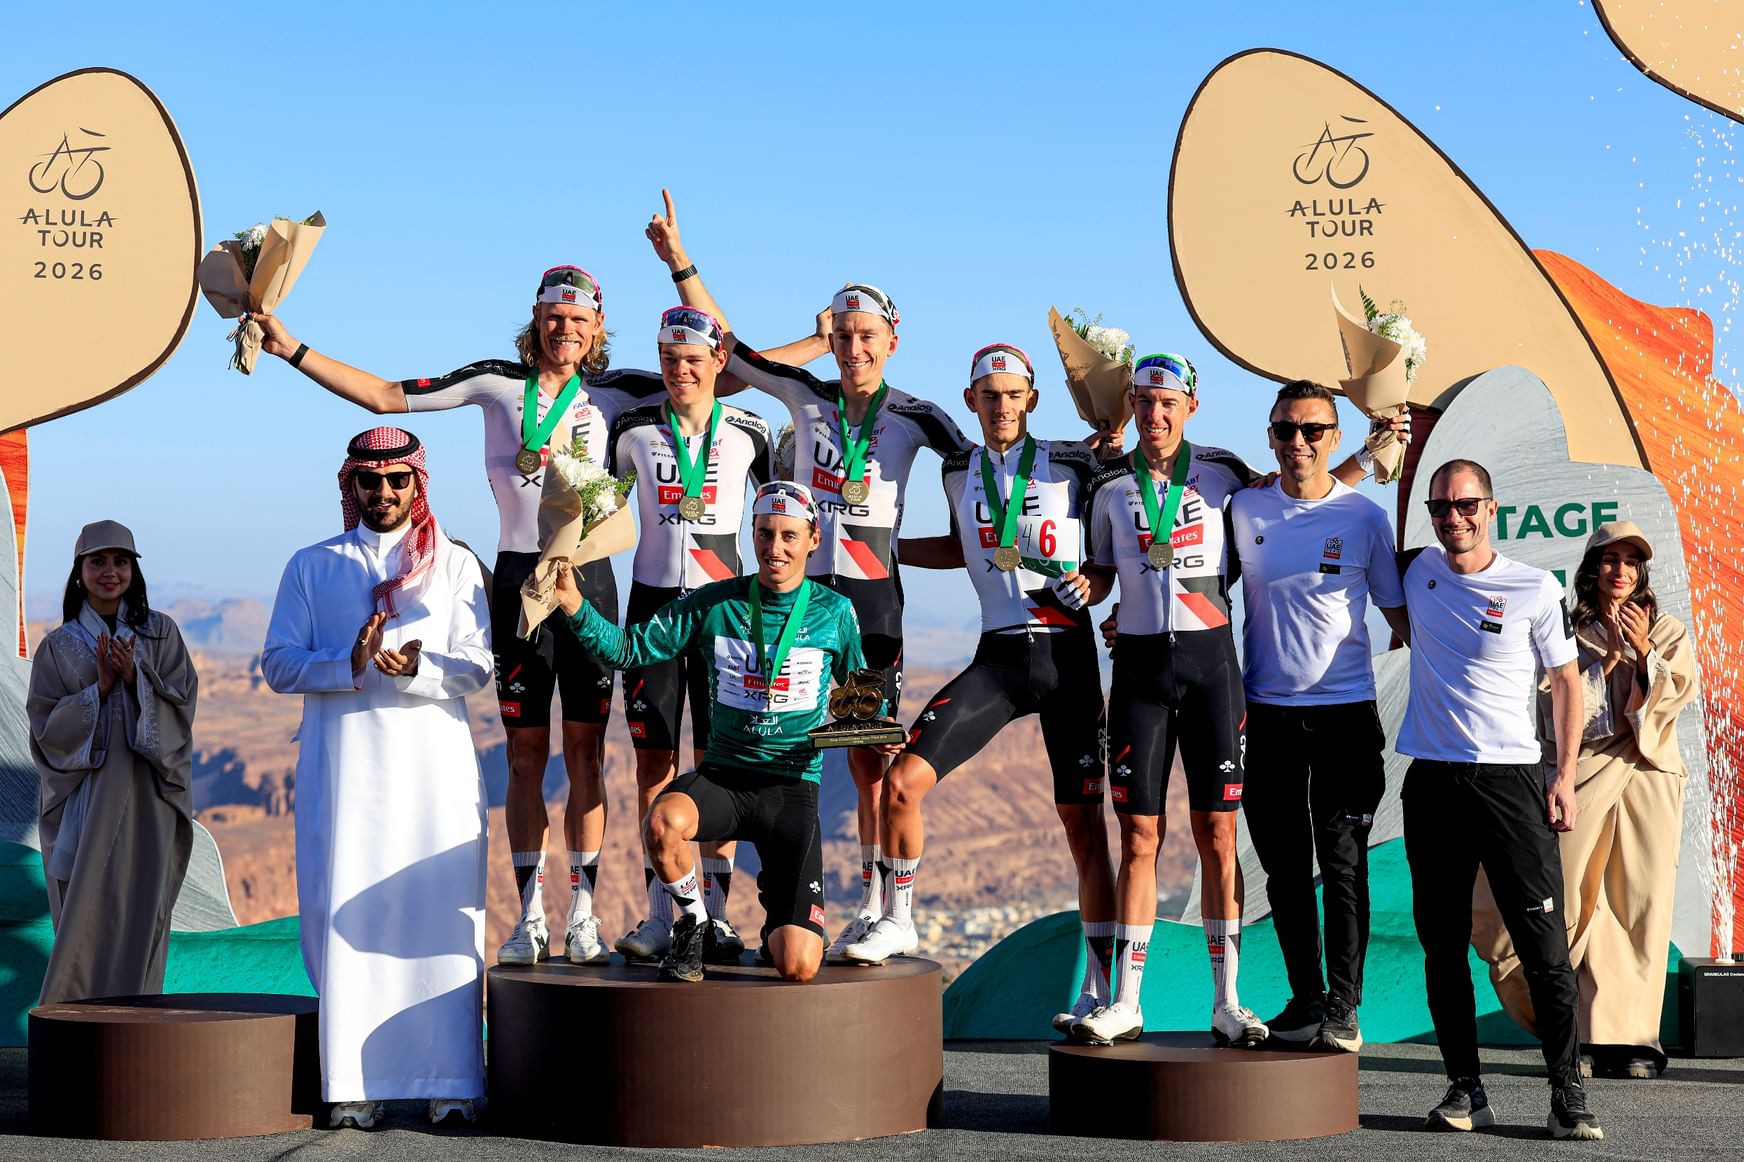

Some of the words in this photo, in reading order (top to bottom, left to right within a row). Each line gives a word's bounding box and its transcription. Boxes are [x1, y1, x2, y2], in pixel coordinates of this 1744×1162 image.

[1285, 197, 1388, 217] ALULA
[17, 208, 120, 228] ALULA
[1306, 219, 1374, 238] TOUR
[37, 229, 104, 249] TOUR
[1305, 251, 1375, 270] 2026
[34, 261, 103, 280] 2026
[897, 403, 933, 413] Analog
[734, 416, 768, 434] Analog
[1055, 450, 1092, 462] Analog
[1205, 449, 1236, 459] Analog
[656, 462, 719, 484] UE
[1091, 467, 1128, 485] Analog
[663, 488, 712, 500] Emes
[817, 500, 870, 517] XRG
[1134, 499, 1203, 531] UE
[1496, 501, 1618, 540] TAGE
[1039, 519, 1057, 558] 6
[743, 724, 783, 736] ALULA
